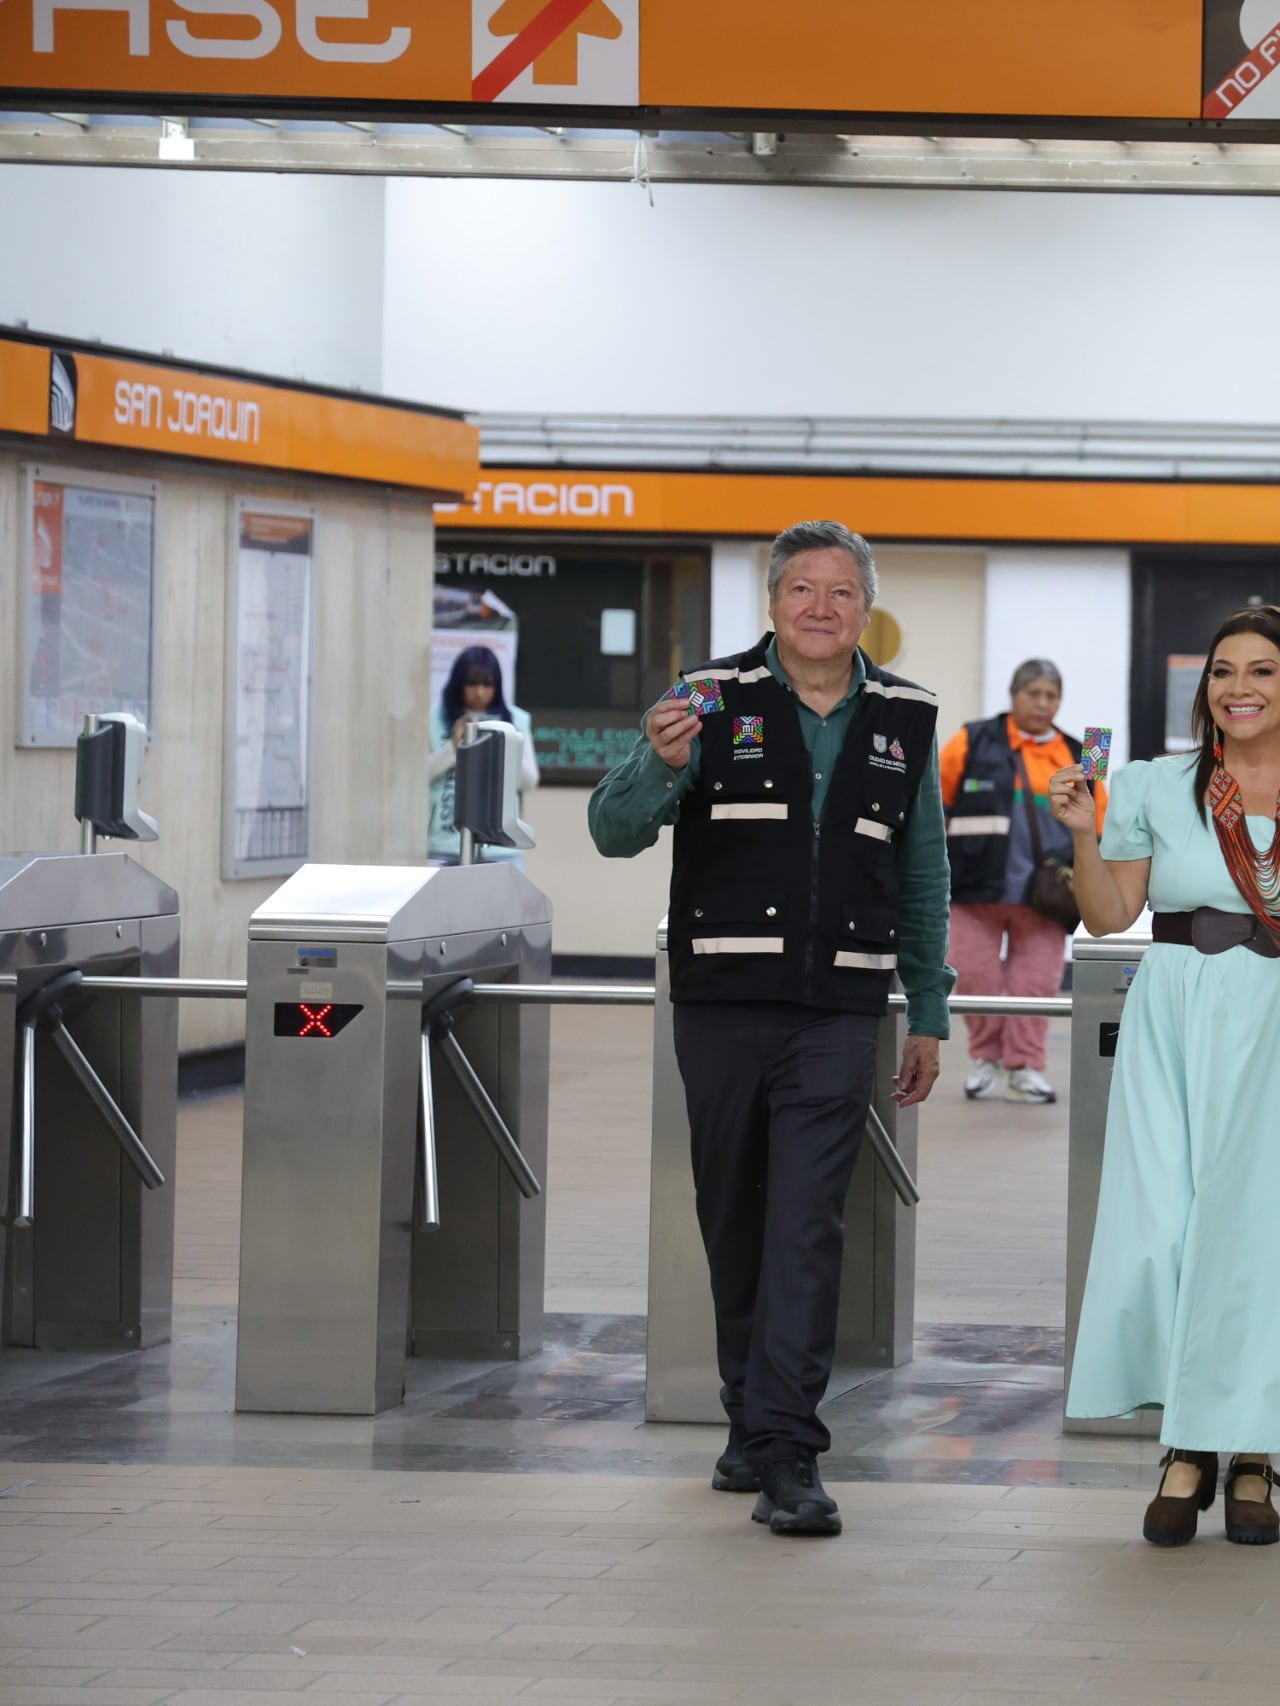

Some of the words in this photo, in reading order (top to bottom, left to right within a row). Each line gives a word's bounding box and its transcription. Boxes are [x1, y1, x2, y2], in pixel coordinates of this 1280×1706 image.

[1215, 61, 1261, 108] NO
[113, 379, 162, 429] SAN
[167, 389, 260, 444] JOAQUIN
[433, 482, 634, 517] TACION
